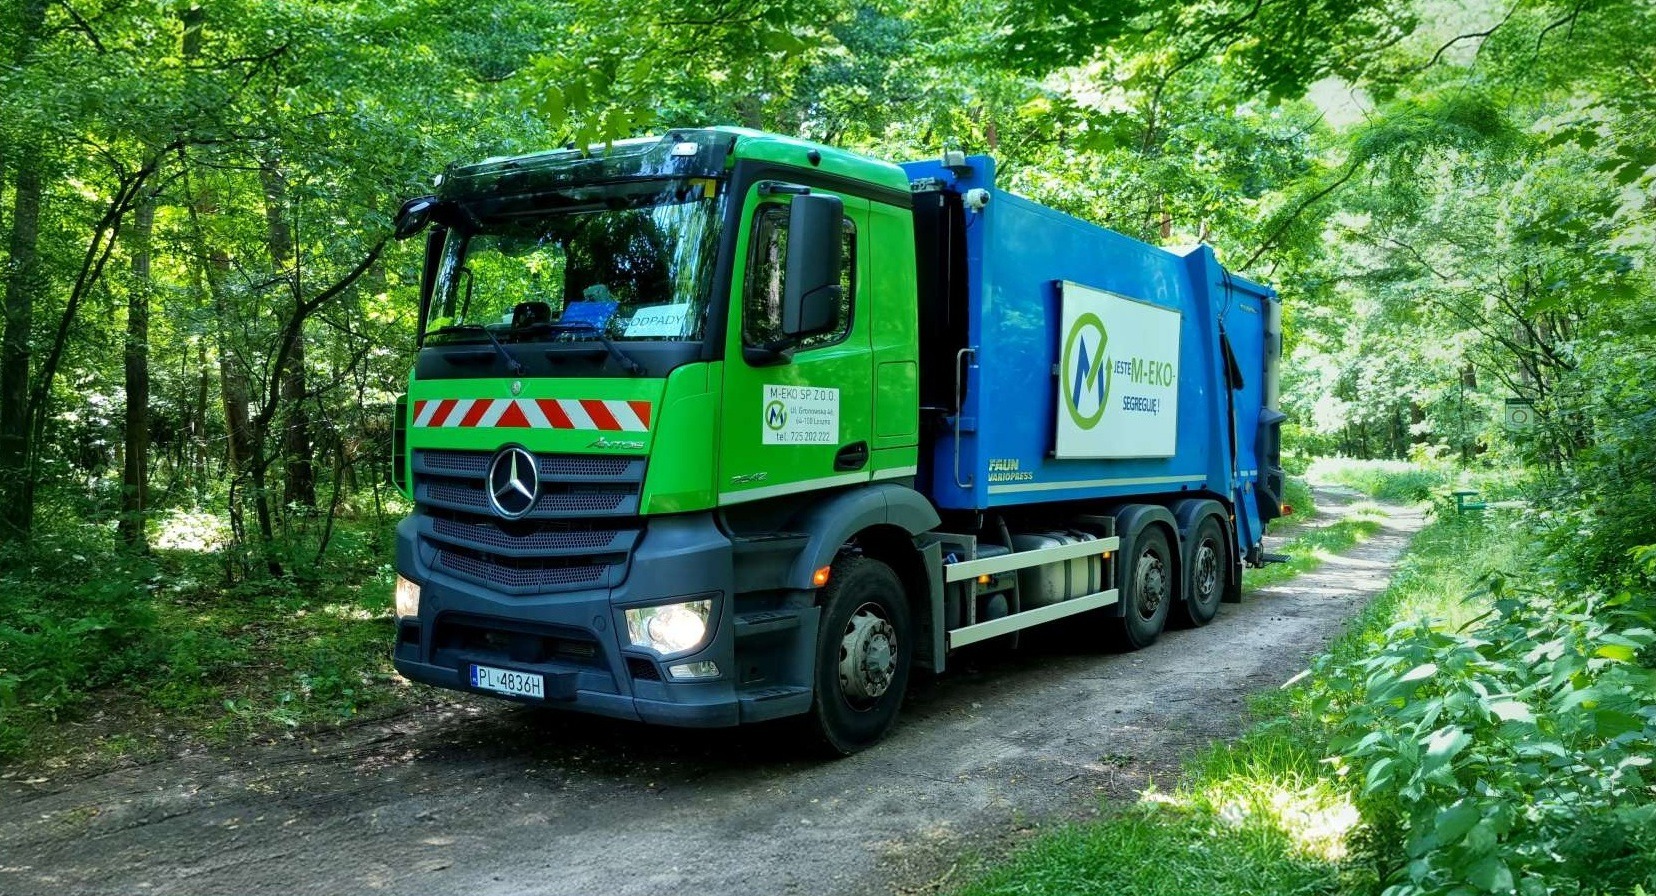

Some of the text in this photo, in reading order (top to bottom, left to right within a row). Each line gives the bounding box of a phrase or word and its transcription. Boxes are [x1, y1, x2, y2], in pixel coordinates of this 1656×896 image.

[631, 316, 683, 327] ODPADY
[770, 387, 798, 400] M-EKO
[791, 431, 804, 442] 725
[988, 458, 1019, 471] FAUN
[479, 668, 541, 695] PL 4836H
